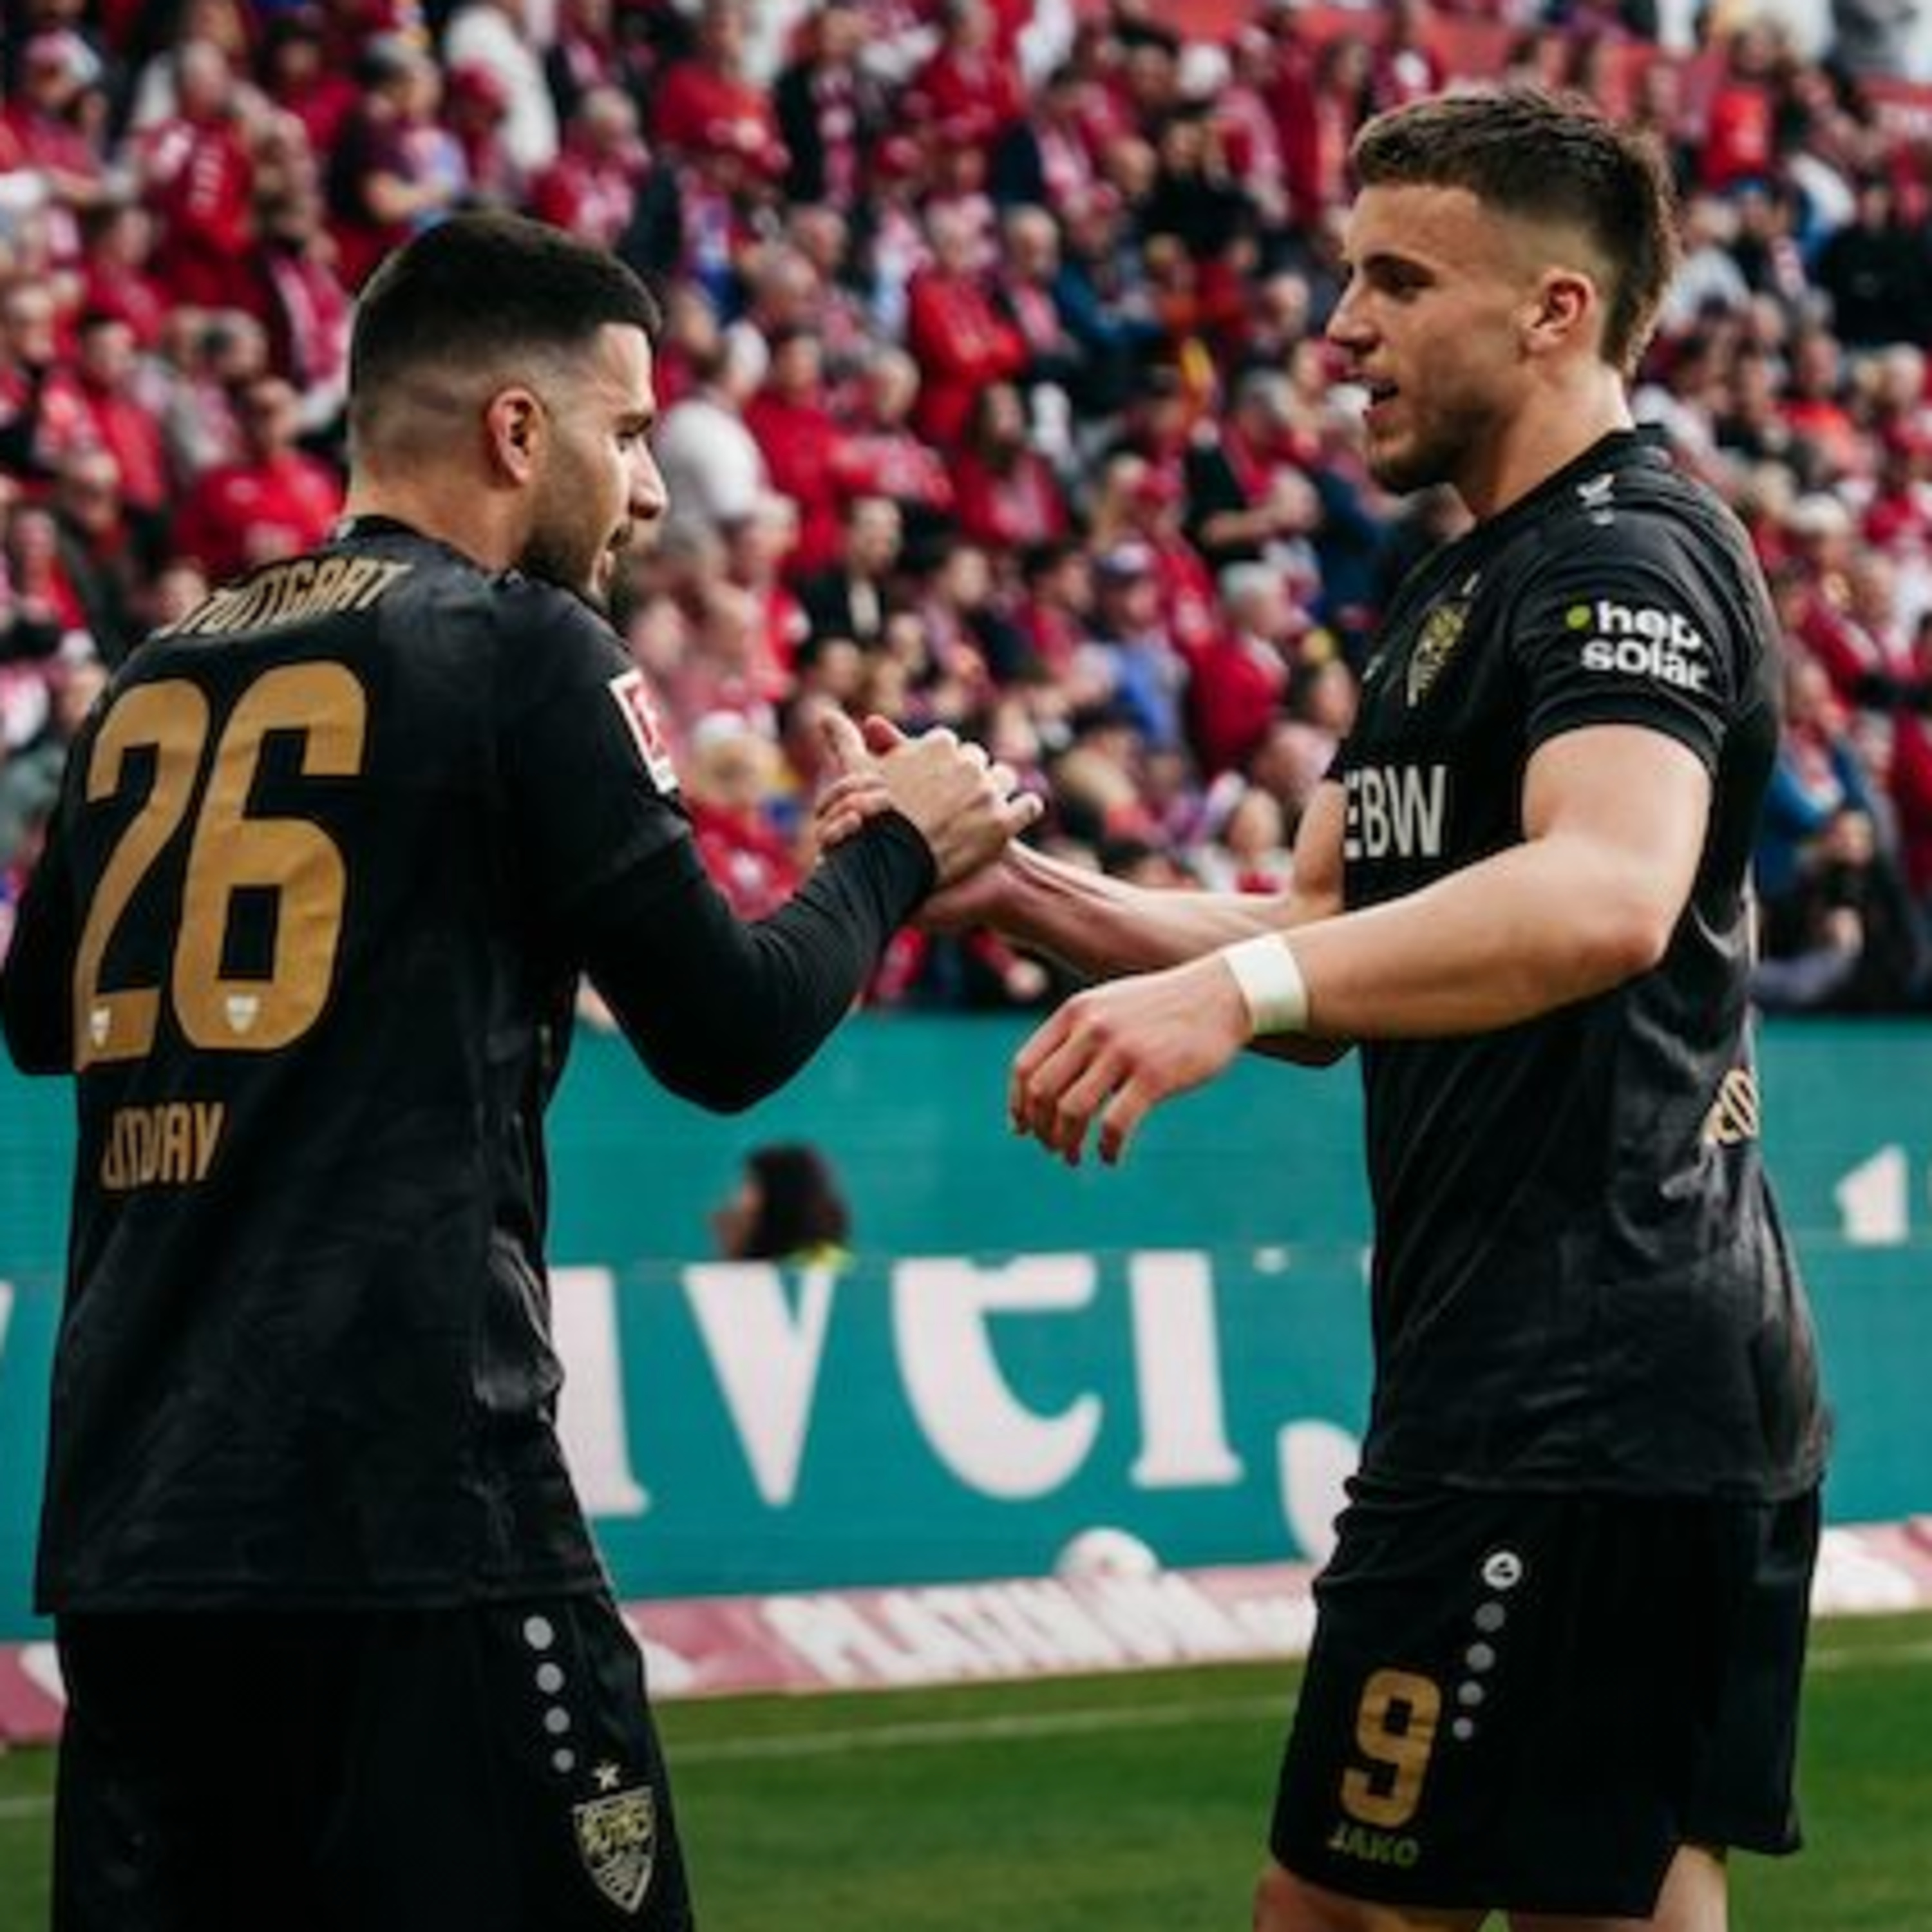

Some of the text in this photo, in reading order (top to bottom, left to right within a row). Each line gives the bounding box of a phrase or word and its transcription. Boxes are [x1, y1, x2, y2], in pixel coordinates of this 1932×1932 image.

[1581, 638, 1709, 691] solar
[73, 660, 366, 1072] 26
[1340, 1668, 1442, 1828] 9
